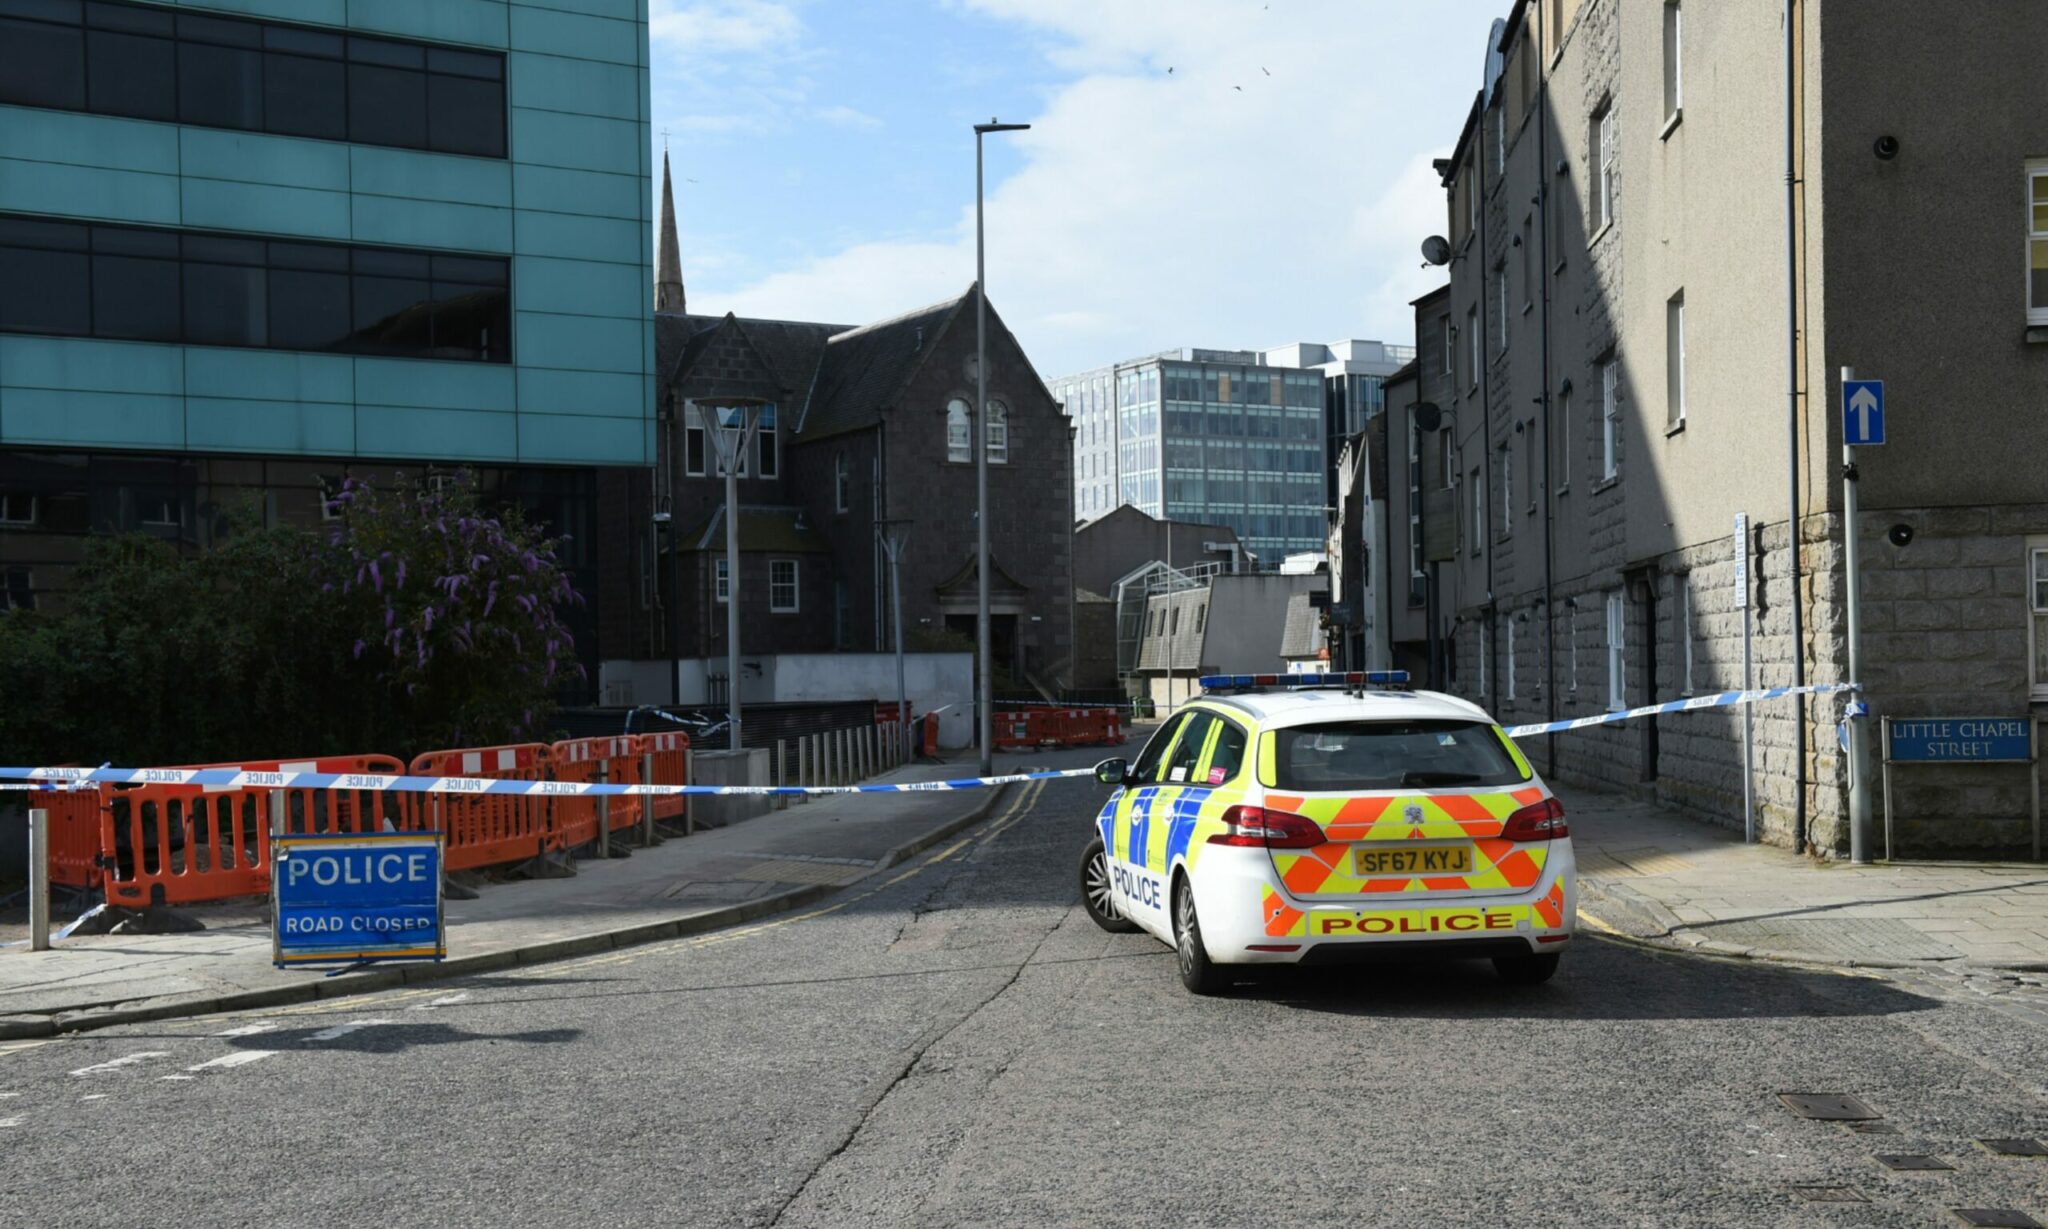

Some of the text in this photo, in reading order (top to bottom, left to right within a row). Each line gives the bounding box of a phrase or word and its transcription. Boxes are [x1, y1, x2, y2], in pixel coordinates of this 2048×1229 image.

[1893, 722, 2027, 738] LITTLE CHAPEL
[1927, 741, 1993, 757] STREET
[288, 853, 428, 886] POLICE
[1363, 850, 1465, 872] SF67 KYJ
[1113, 865, 1162, 911] POLICE
[286, 915, 431, 933] ROAD CLOSED
[1321, 912, 1513, 934] POLICE
